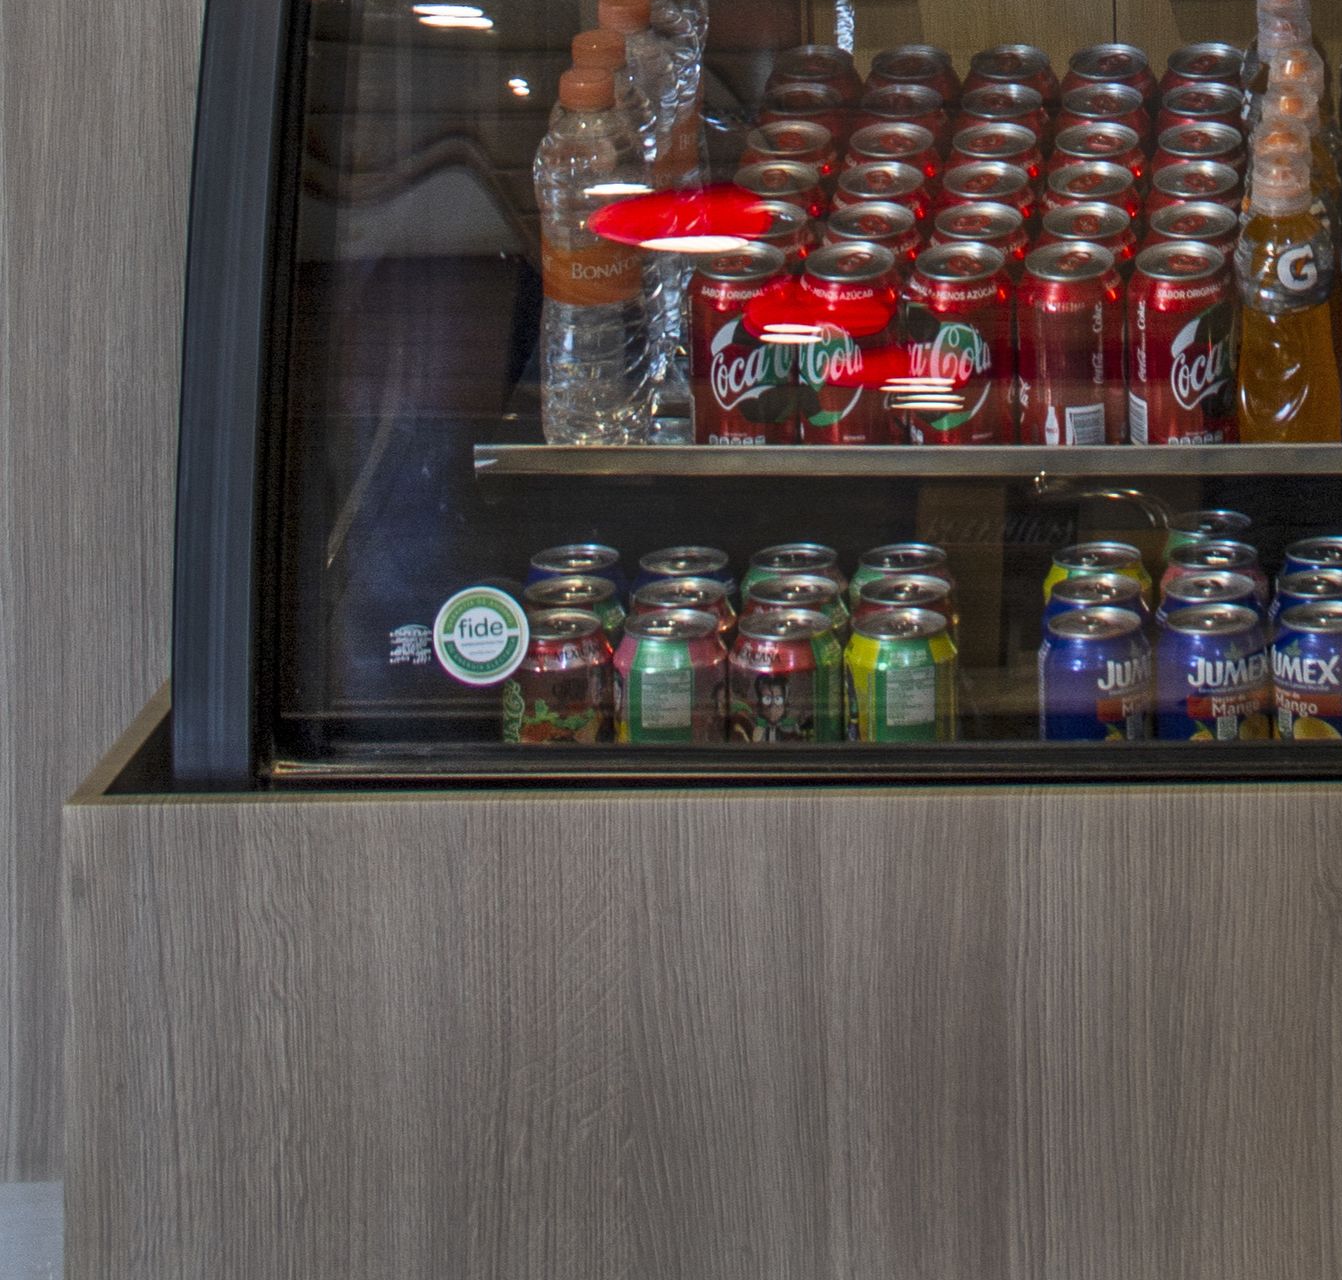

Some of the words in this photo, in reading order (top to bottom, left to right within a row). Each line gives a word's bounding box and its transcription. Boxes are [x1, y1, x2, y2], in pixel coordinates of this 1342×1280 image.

[571, 254, 641, 280] BONAFO
[1277, 244, 1318, 291] G
[459, 617, 504, 640] fide
[1097, 654, 1149, 690] JUM
[1211, 699, 1260, 719] Mango
